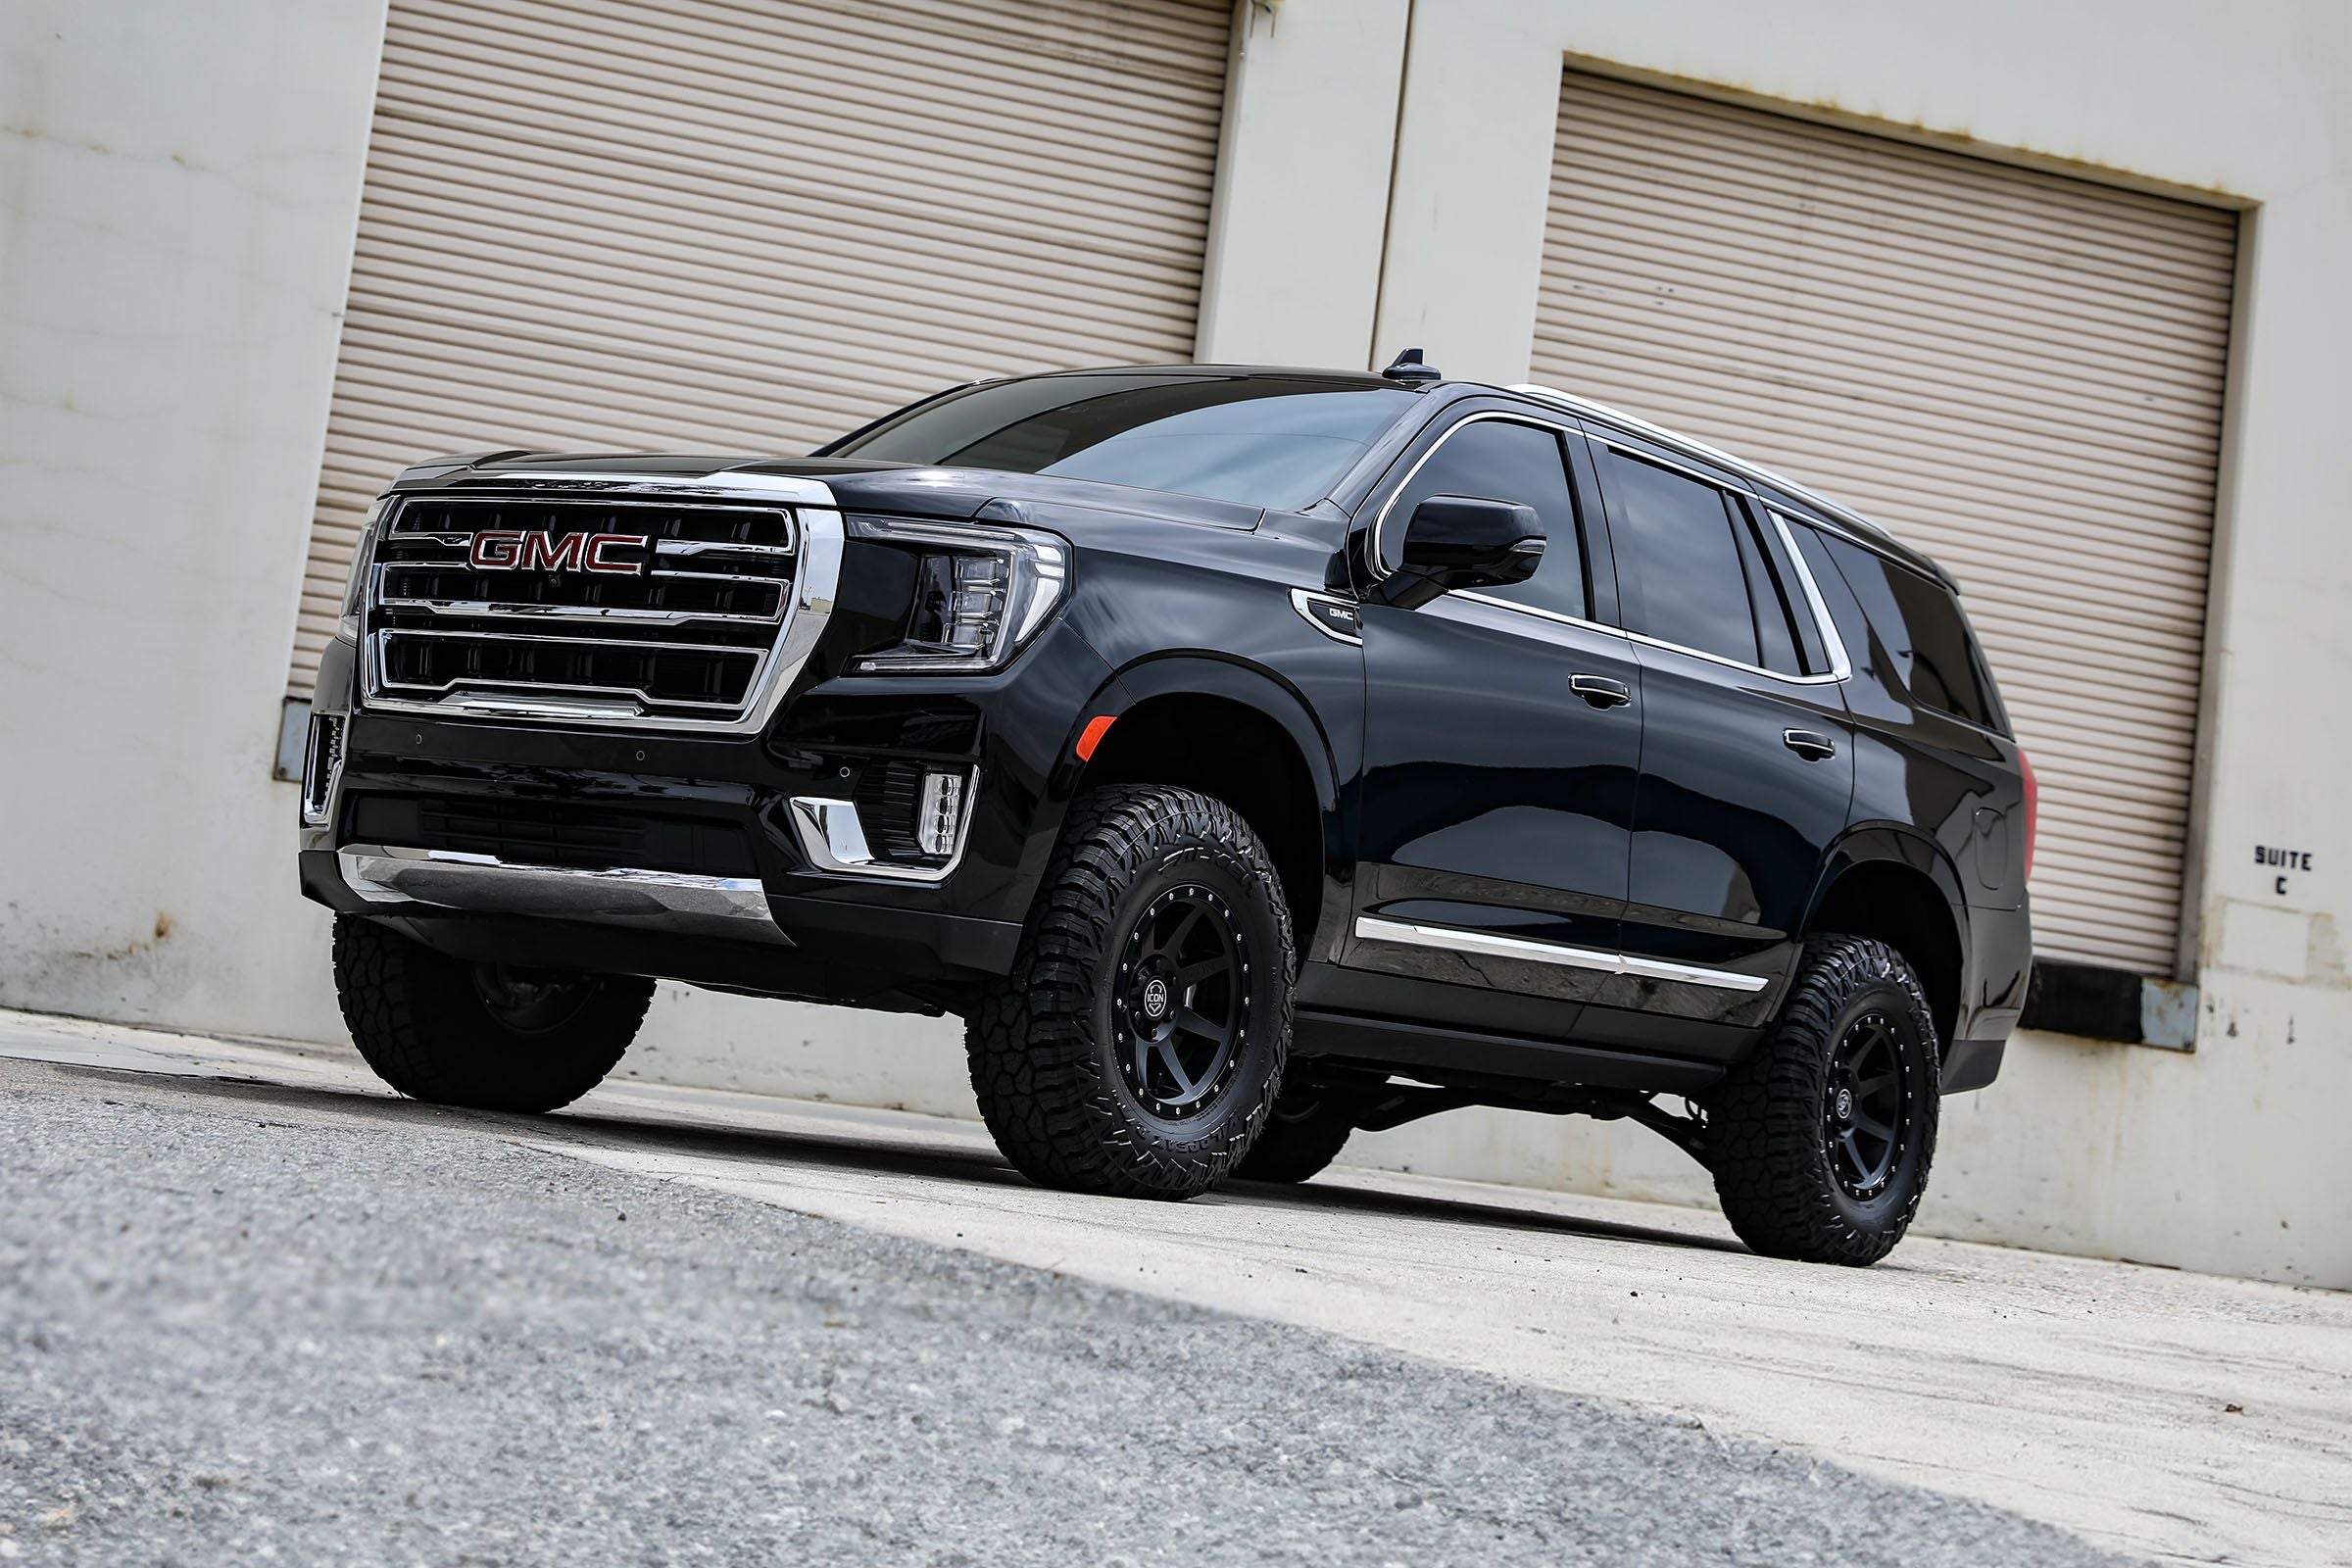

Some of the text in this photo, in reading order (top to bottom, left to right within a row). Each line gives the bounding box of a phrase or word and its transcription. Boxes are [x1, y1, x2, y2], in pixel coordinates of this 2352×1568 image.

[469, 529, 649, 575] GMC
[1329, 608, 1353, 620] GMC
[2255, 846, 2312, 871] SUITE
[2276, 875, 2287, 896] C
[1147, 993, 1163, 1002] ICON
